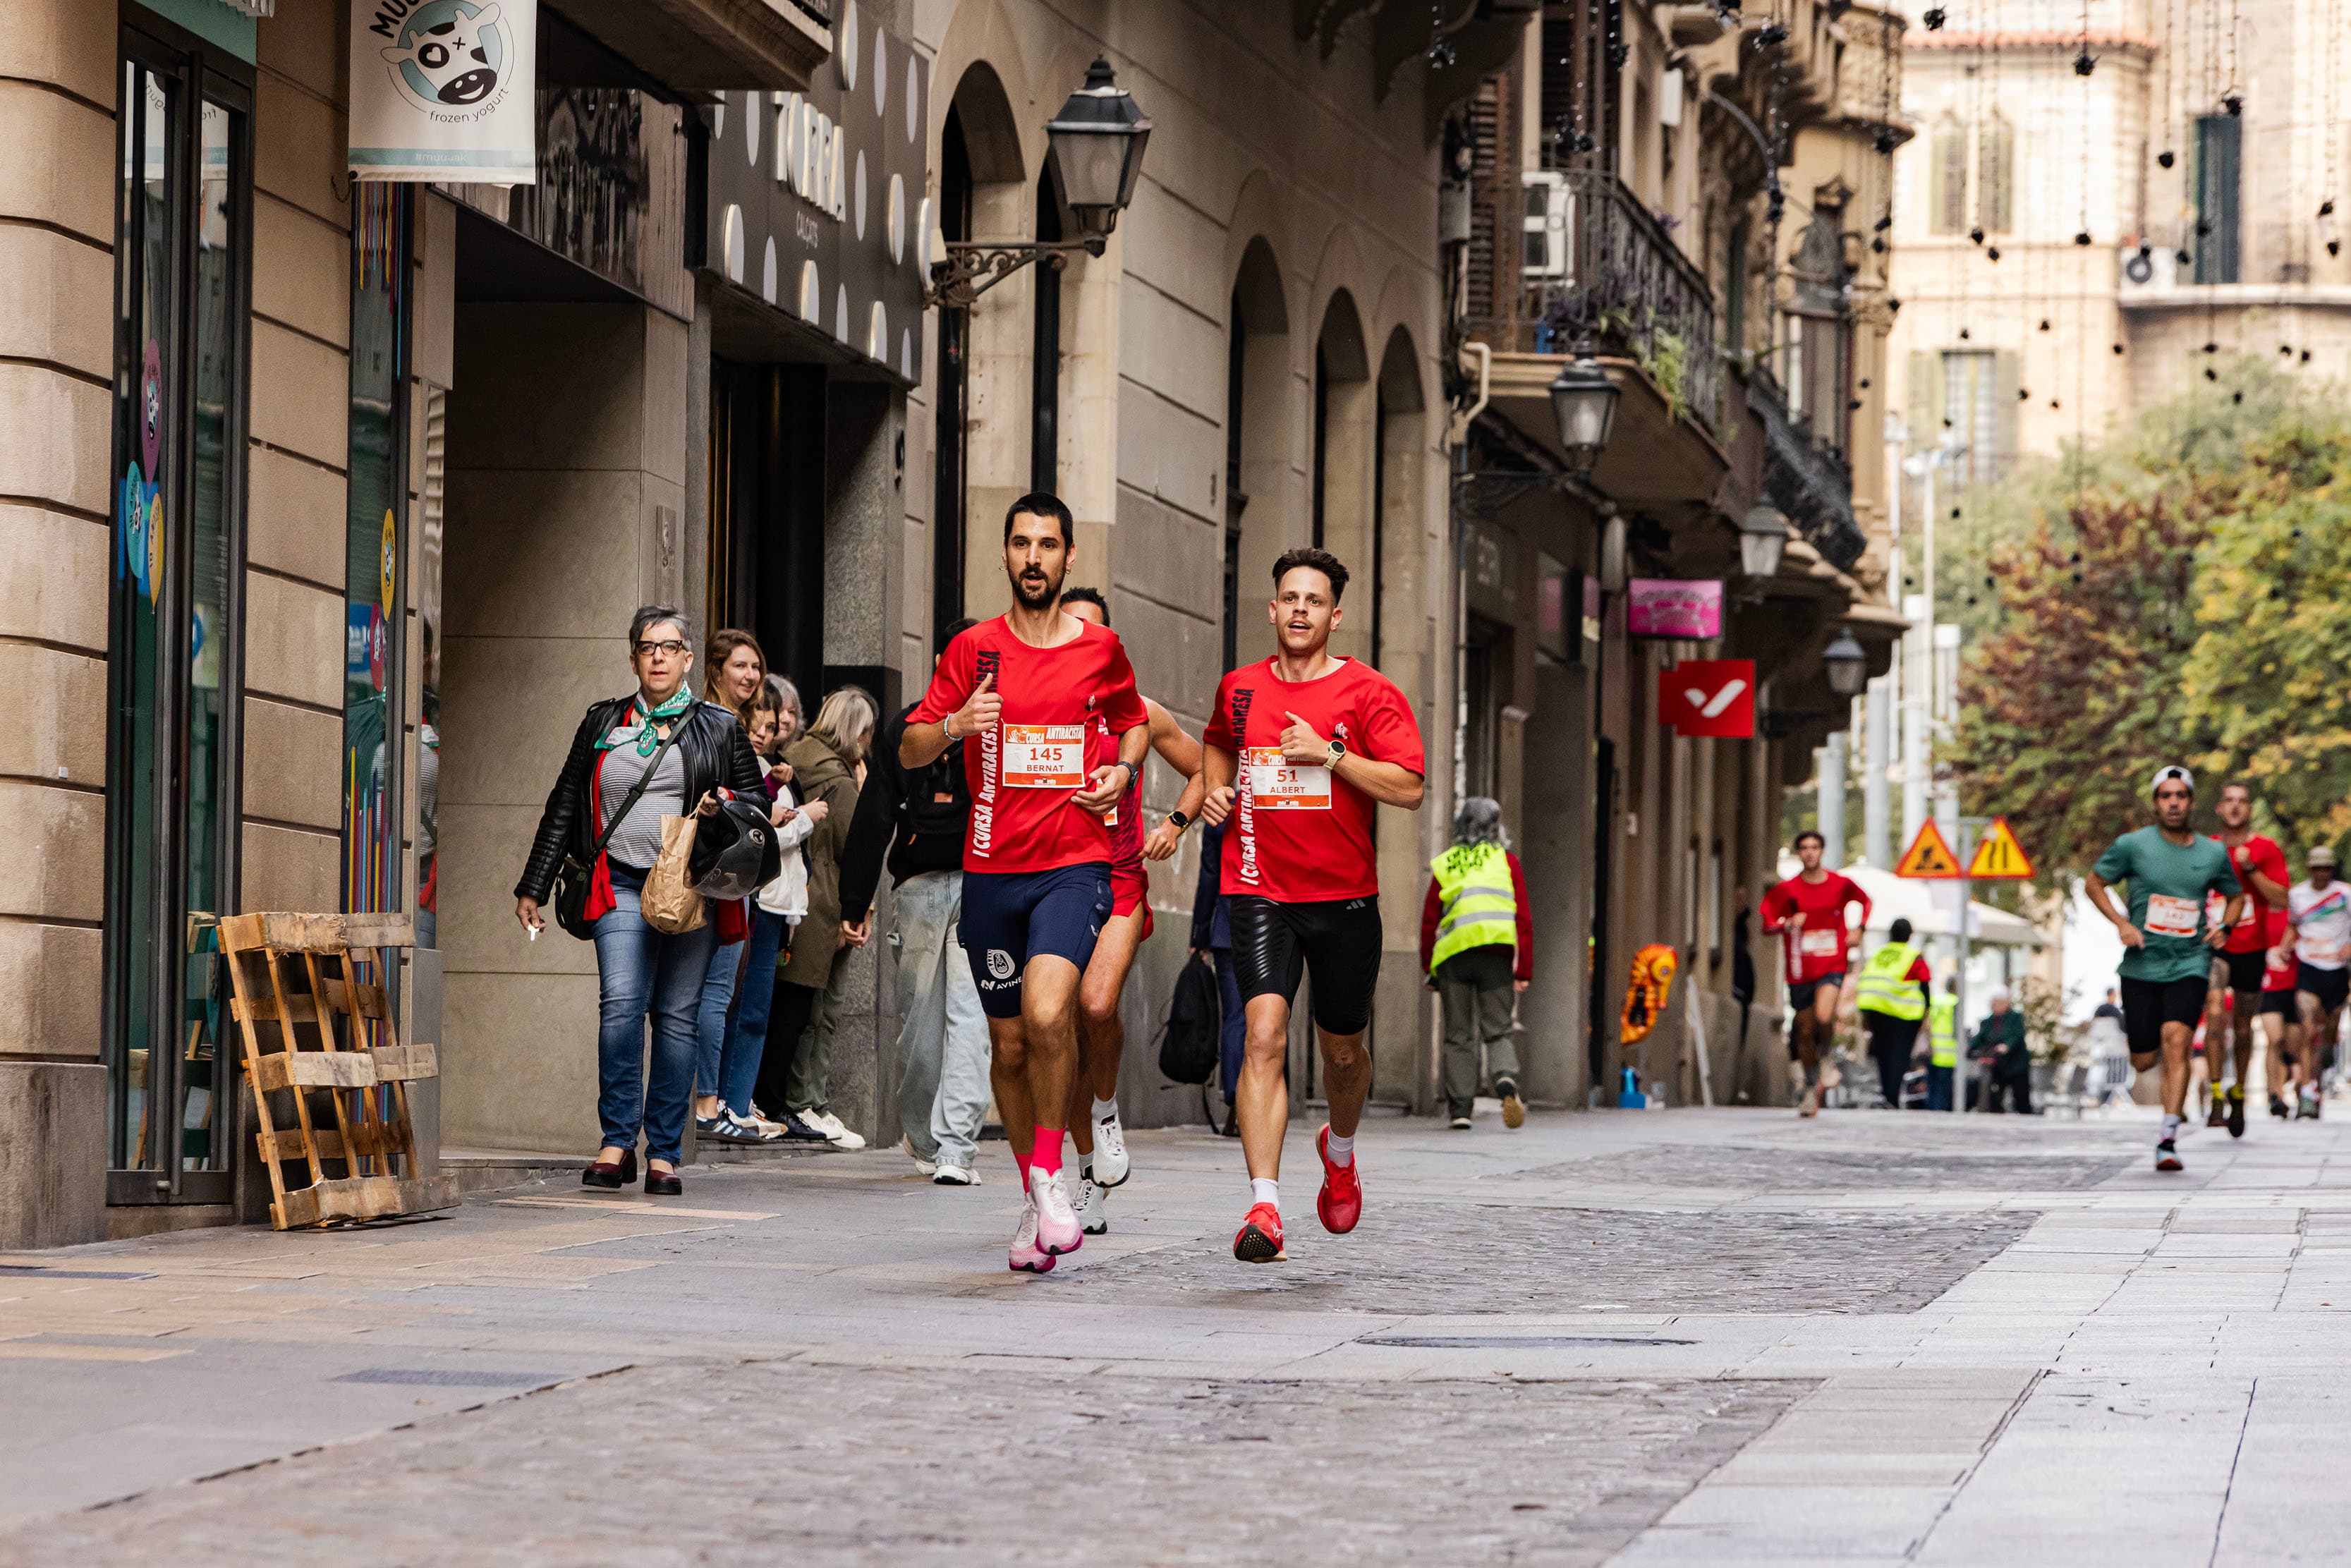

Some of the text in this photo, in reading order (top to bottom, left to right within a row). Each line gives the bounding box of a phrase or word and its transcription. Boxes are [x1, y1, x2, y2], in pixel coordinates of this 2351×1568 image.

[369, 0, 420, 39] MU
[430, 87, 509, 123] frozen yogurt
[770, 91, 846, 224] TORRA
[1026, 732, 1045, 744] CURSA
[1045, 727, 1083, 740] ANTIRACISTA
[1232, 688, 1256, 748] MANRESA
[978, 720, 999, 804] ANTIRACIS
[1026, 764, 1064, 772] BERNAT
[1030, 747, 1063, 761] 145
[1239, 749, 1255, 834] ANTIRACISTA
[1270, 786, 1306, 794] ALBERT
[1277, 769, 1299, 783] 51
[973, 803, 993, 849] CURSA
[1240, 835, 1260, 878] CURSA
